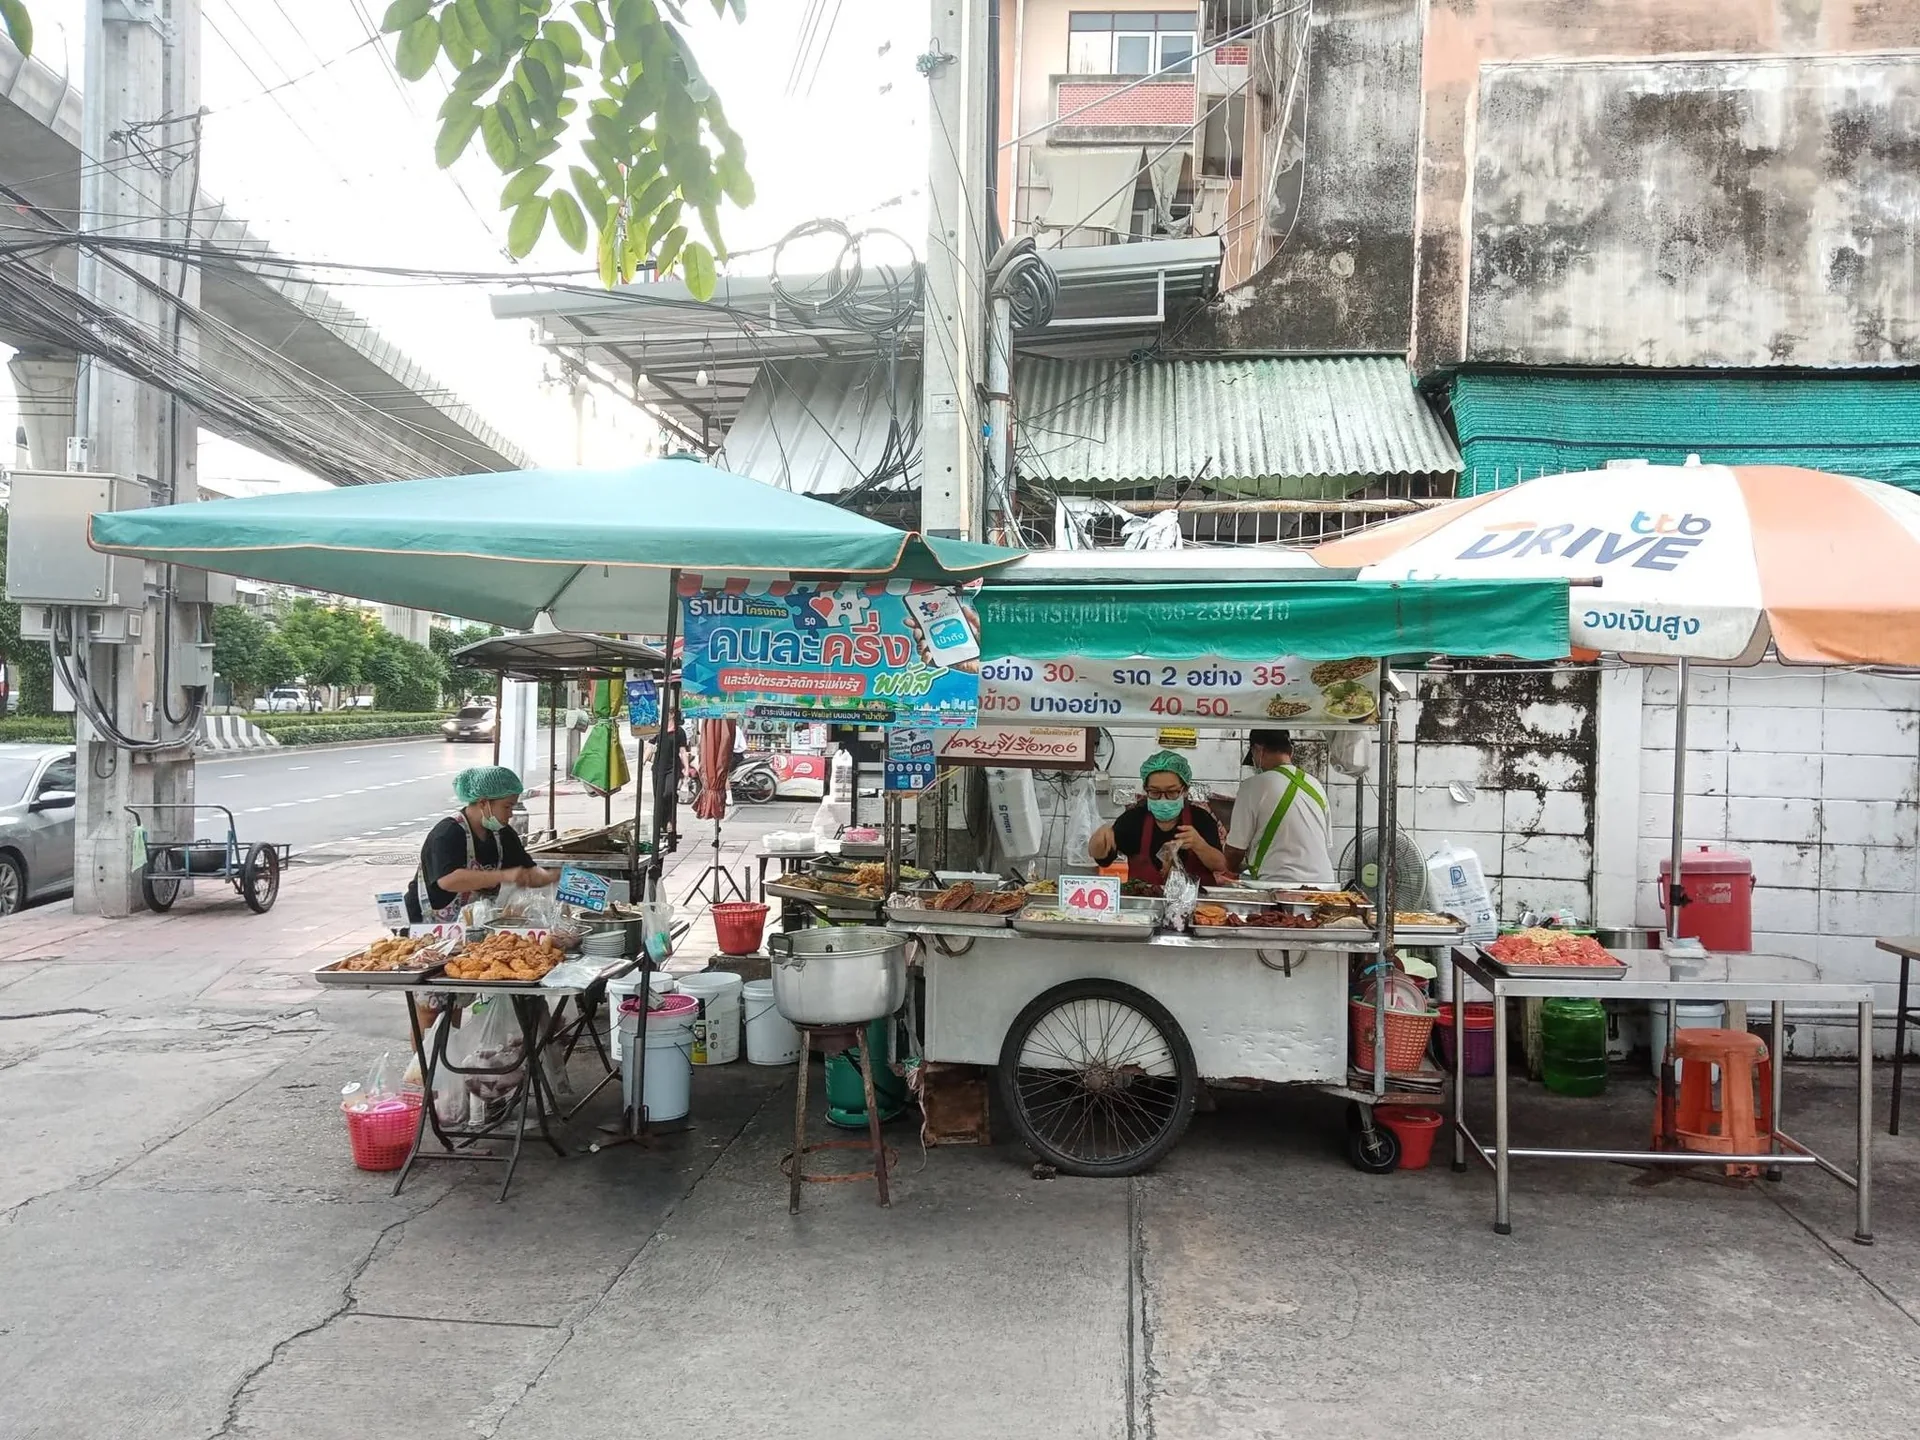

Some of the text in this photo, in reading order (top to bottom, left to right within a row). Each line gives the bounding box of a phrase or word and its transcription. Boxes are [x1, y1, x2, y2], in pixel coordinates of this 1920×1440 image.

[1630, 511, 1712, 535] ttb
[1455, 522, 1704, 572] DRIVE
[841, 602, 853, 610] 50
[804, 617, 816, 626] 50
[1583, 607, 1700, 641] วงเงินสูง
[723, 673, 861, 692] และรับบัตรสวัสดิการแห่งรัฐ
[981, 659, 1033, 681] อย่าง
[1112, 669, 1150, 685] ราด
[1161, 666, 1177, 686] 2
[1187, 664, 1242, 686] อย่าง
[978, 688, 1021, 711] ข้าว
[1030, 692, 1122, 714] บางอย่าง
[1068, 887, 1109, 910] 40
